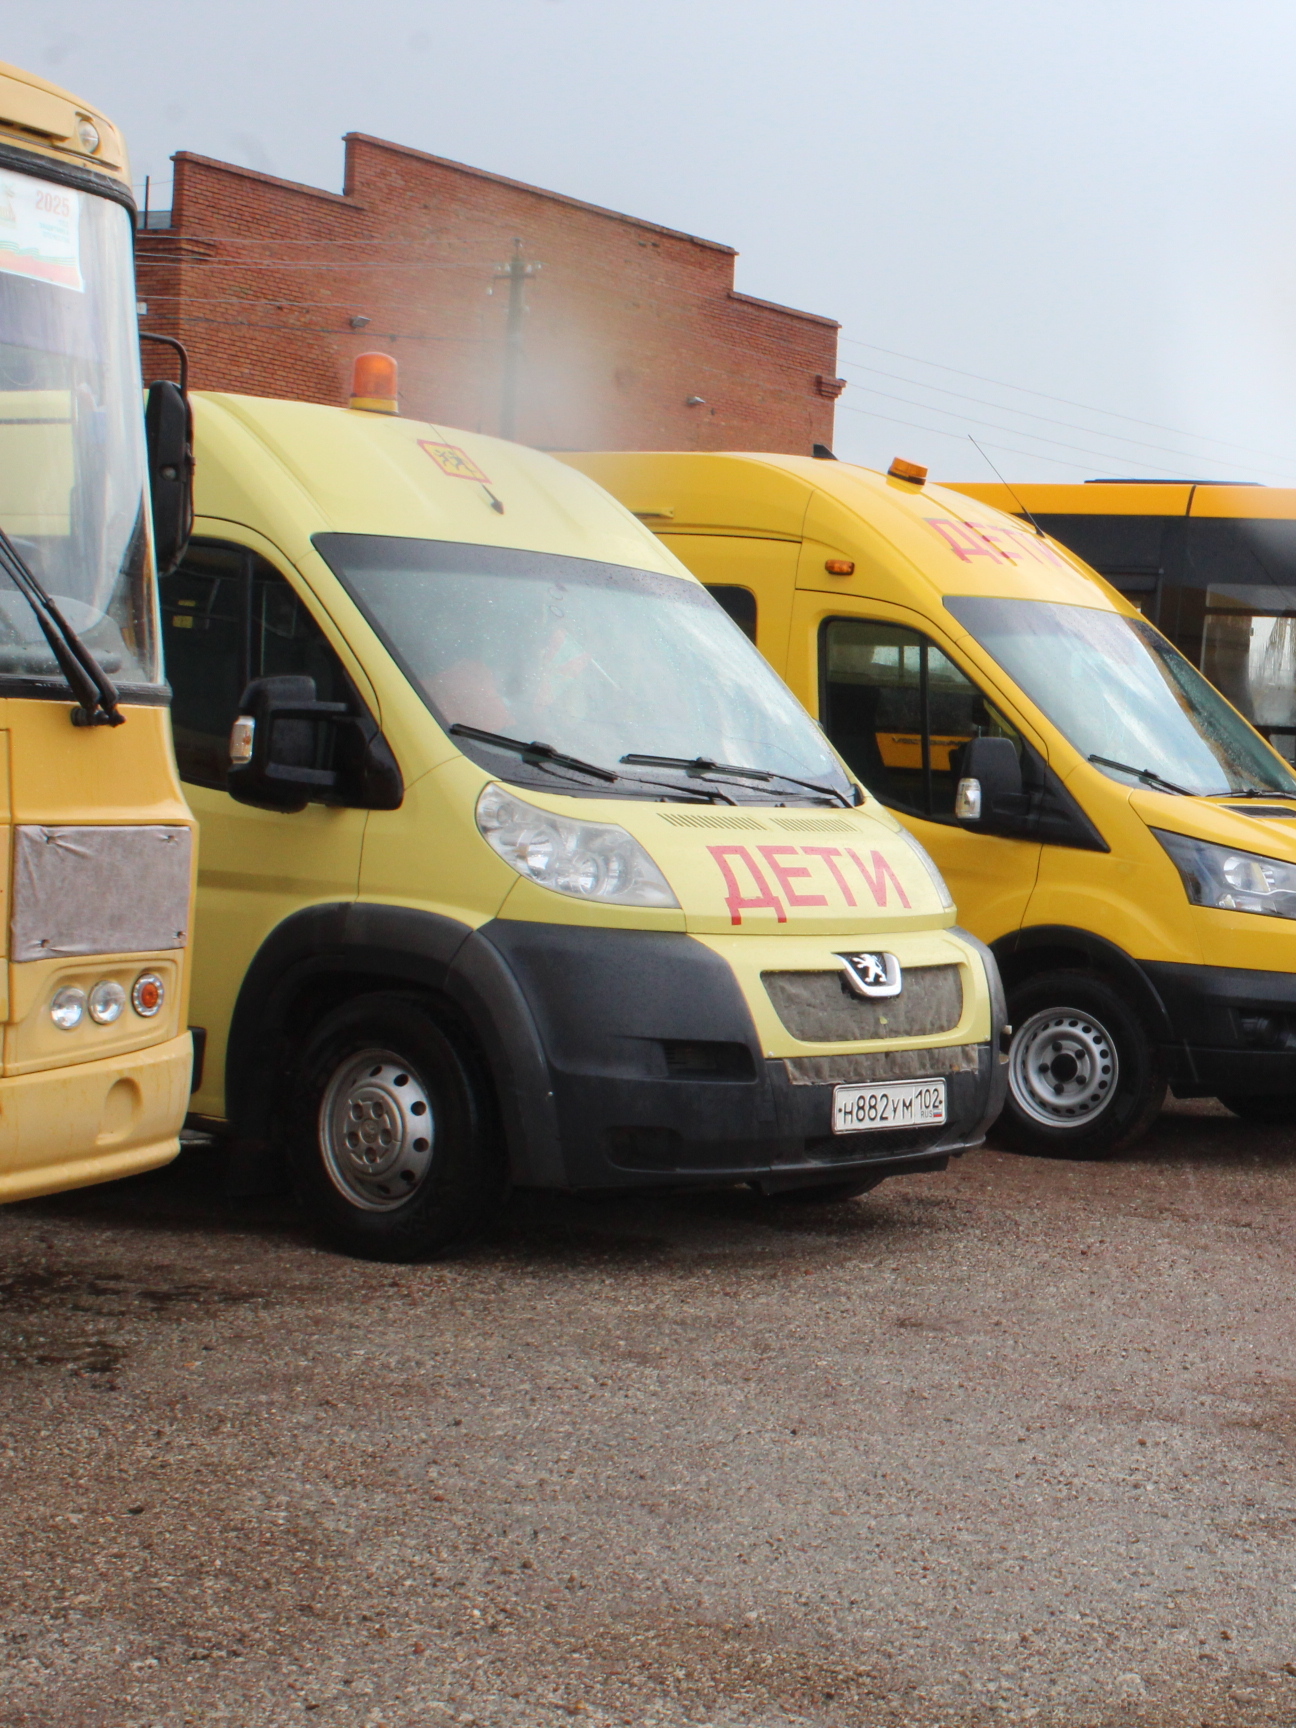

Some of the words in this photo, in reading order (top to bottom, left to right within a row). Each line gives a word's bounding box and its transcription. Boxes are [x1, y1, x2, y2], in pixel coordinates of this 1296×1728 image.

[35, 190, 70, 218] 2025
[706, 845, 912, 925] ДЕТИ
[843, 1093, 913, 1125] Н882УМ
[915, 1088, 940, 1110] 102
[920, 1110, 933, 1119] RUS
